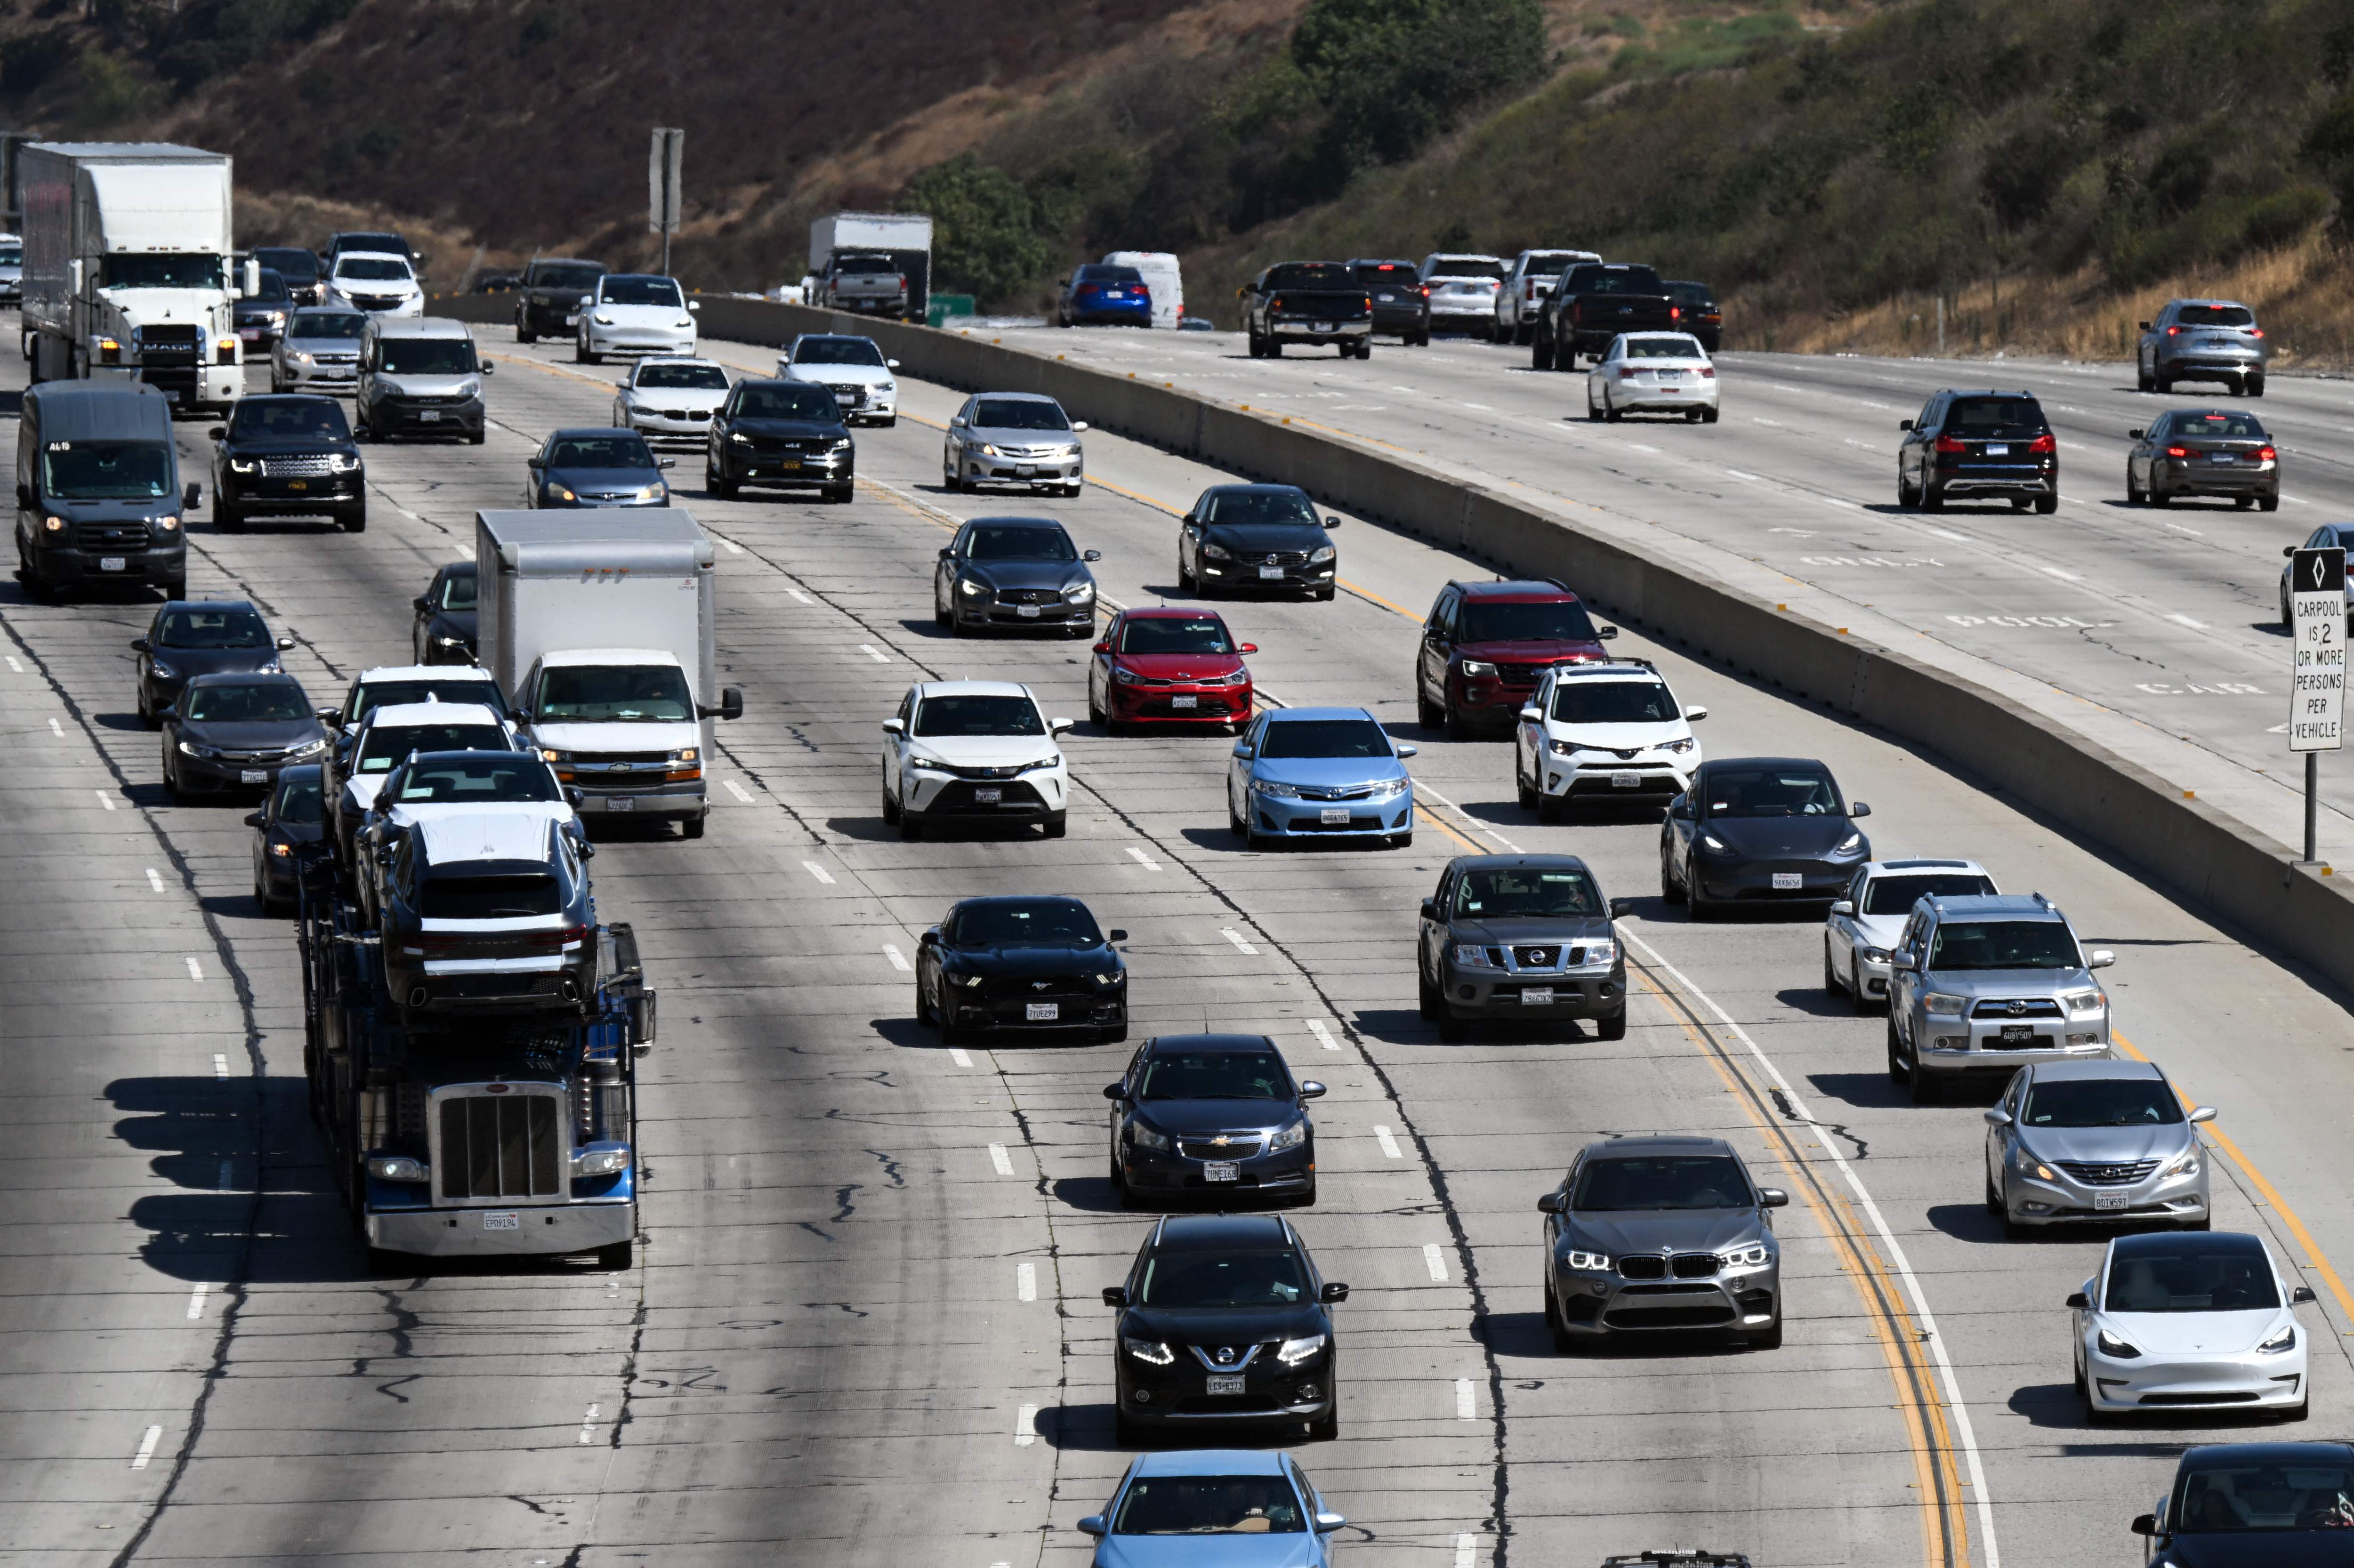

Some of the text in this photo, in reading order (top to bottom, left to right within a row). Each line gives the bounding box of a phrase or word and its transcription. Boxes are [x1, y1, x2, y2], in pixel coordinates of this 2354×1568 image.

[2298, 601, 2342, 617] CARPOOL
[1945, 616, 2113, 627] POOL
[2309, 623, 2331, 643] IS 2
[2298, 650, 2343, 666] OR MORE
[2134, 683, 2269, 694] CAR
[2297, 674, 2342, 690] PERSONS
[2307, 698, 2327, 714] PER
[2296, 722, 2337, 739] VEHICLE
[1206, 1170, 1236, 1179] 7HNE168
[2097, 1198, 2127, 1207] 8DIW597
